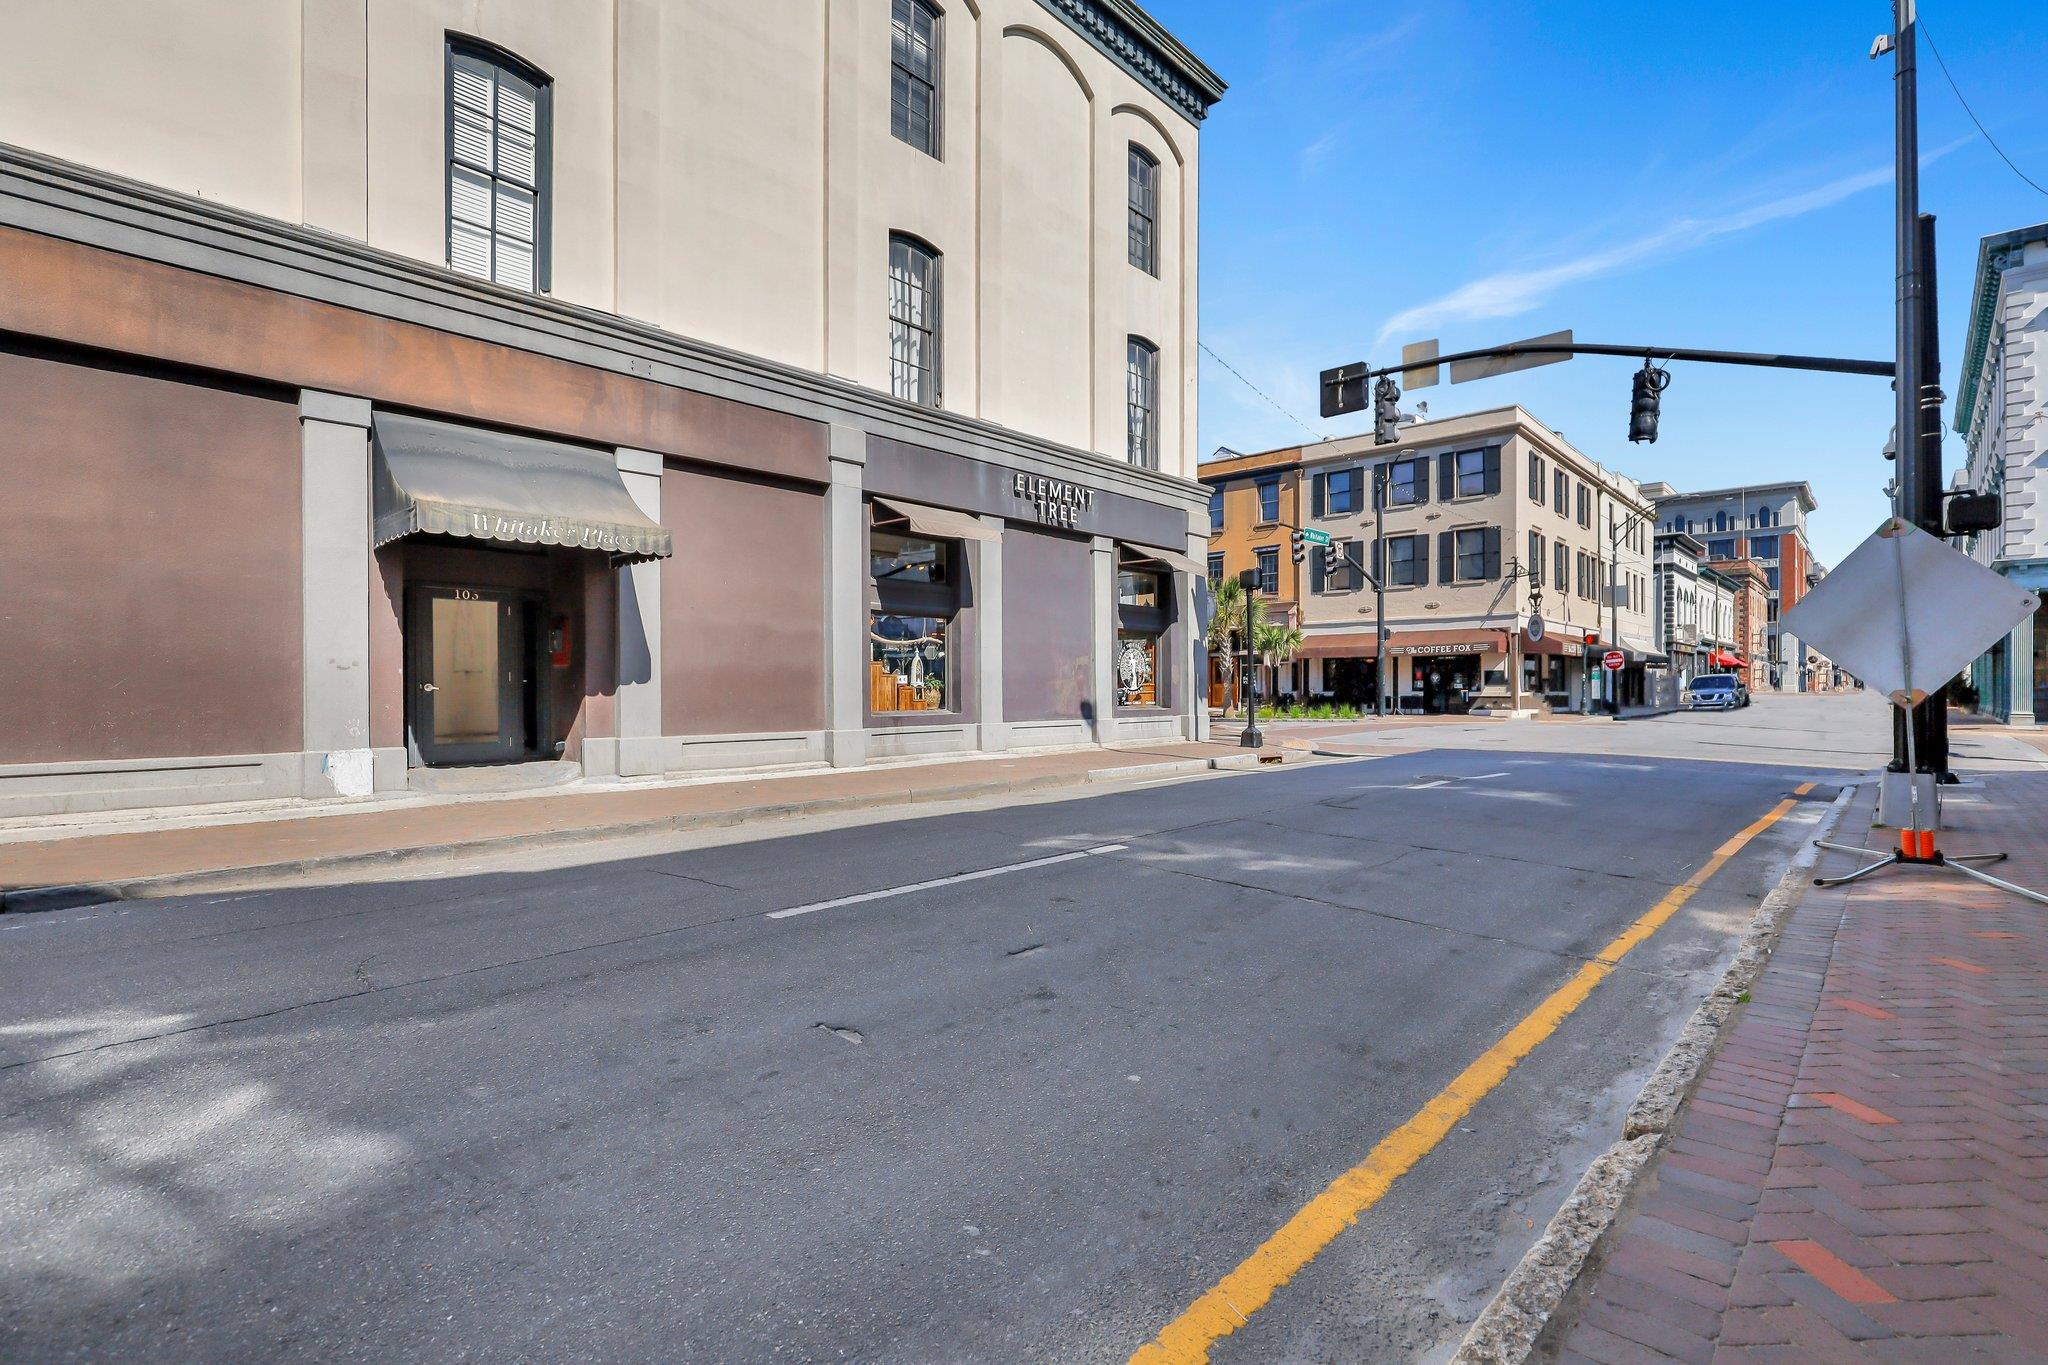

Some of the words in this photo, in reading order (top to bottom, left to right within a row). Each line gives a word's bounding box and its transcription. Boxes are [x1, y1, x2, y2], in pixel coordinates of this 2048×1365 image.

[1014, 473, 1095, 506] ELEMENT
[1037, 499, 1078, 524] TREE
[473, 513, 576, 539] Whitaker
[582, 527, 636, 547] Place
[1417, 645, 1452, 654] COFFEE
[1453, 644, 1471, 652] FOX
